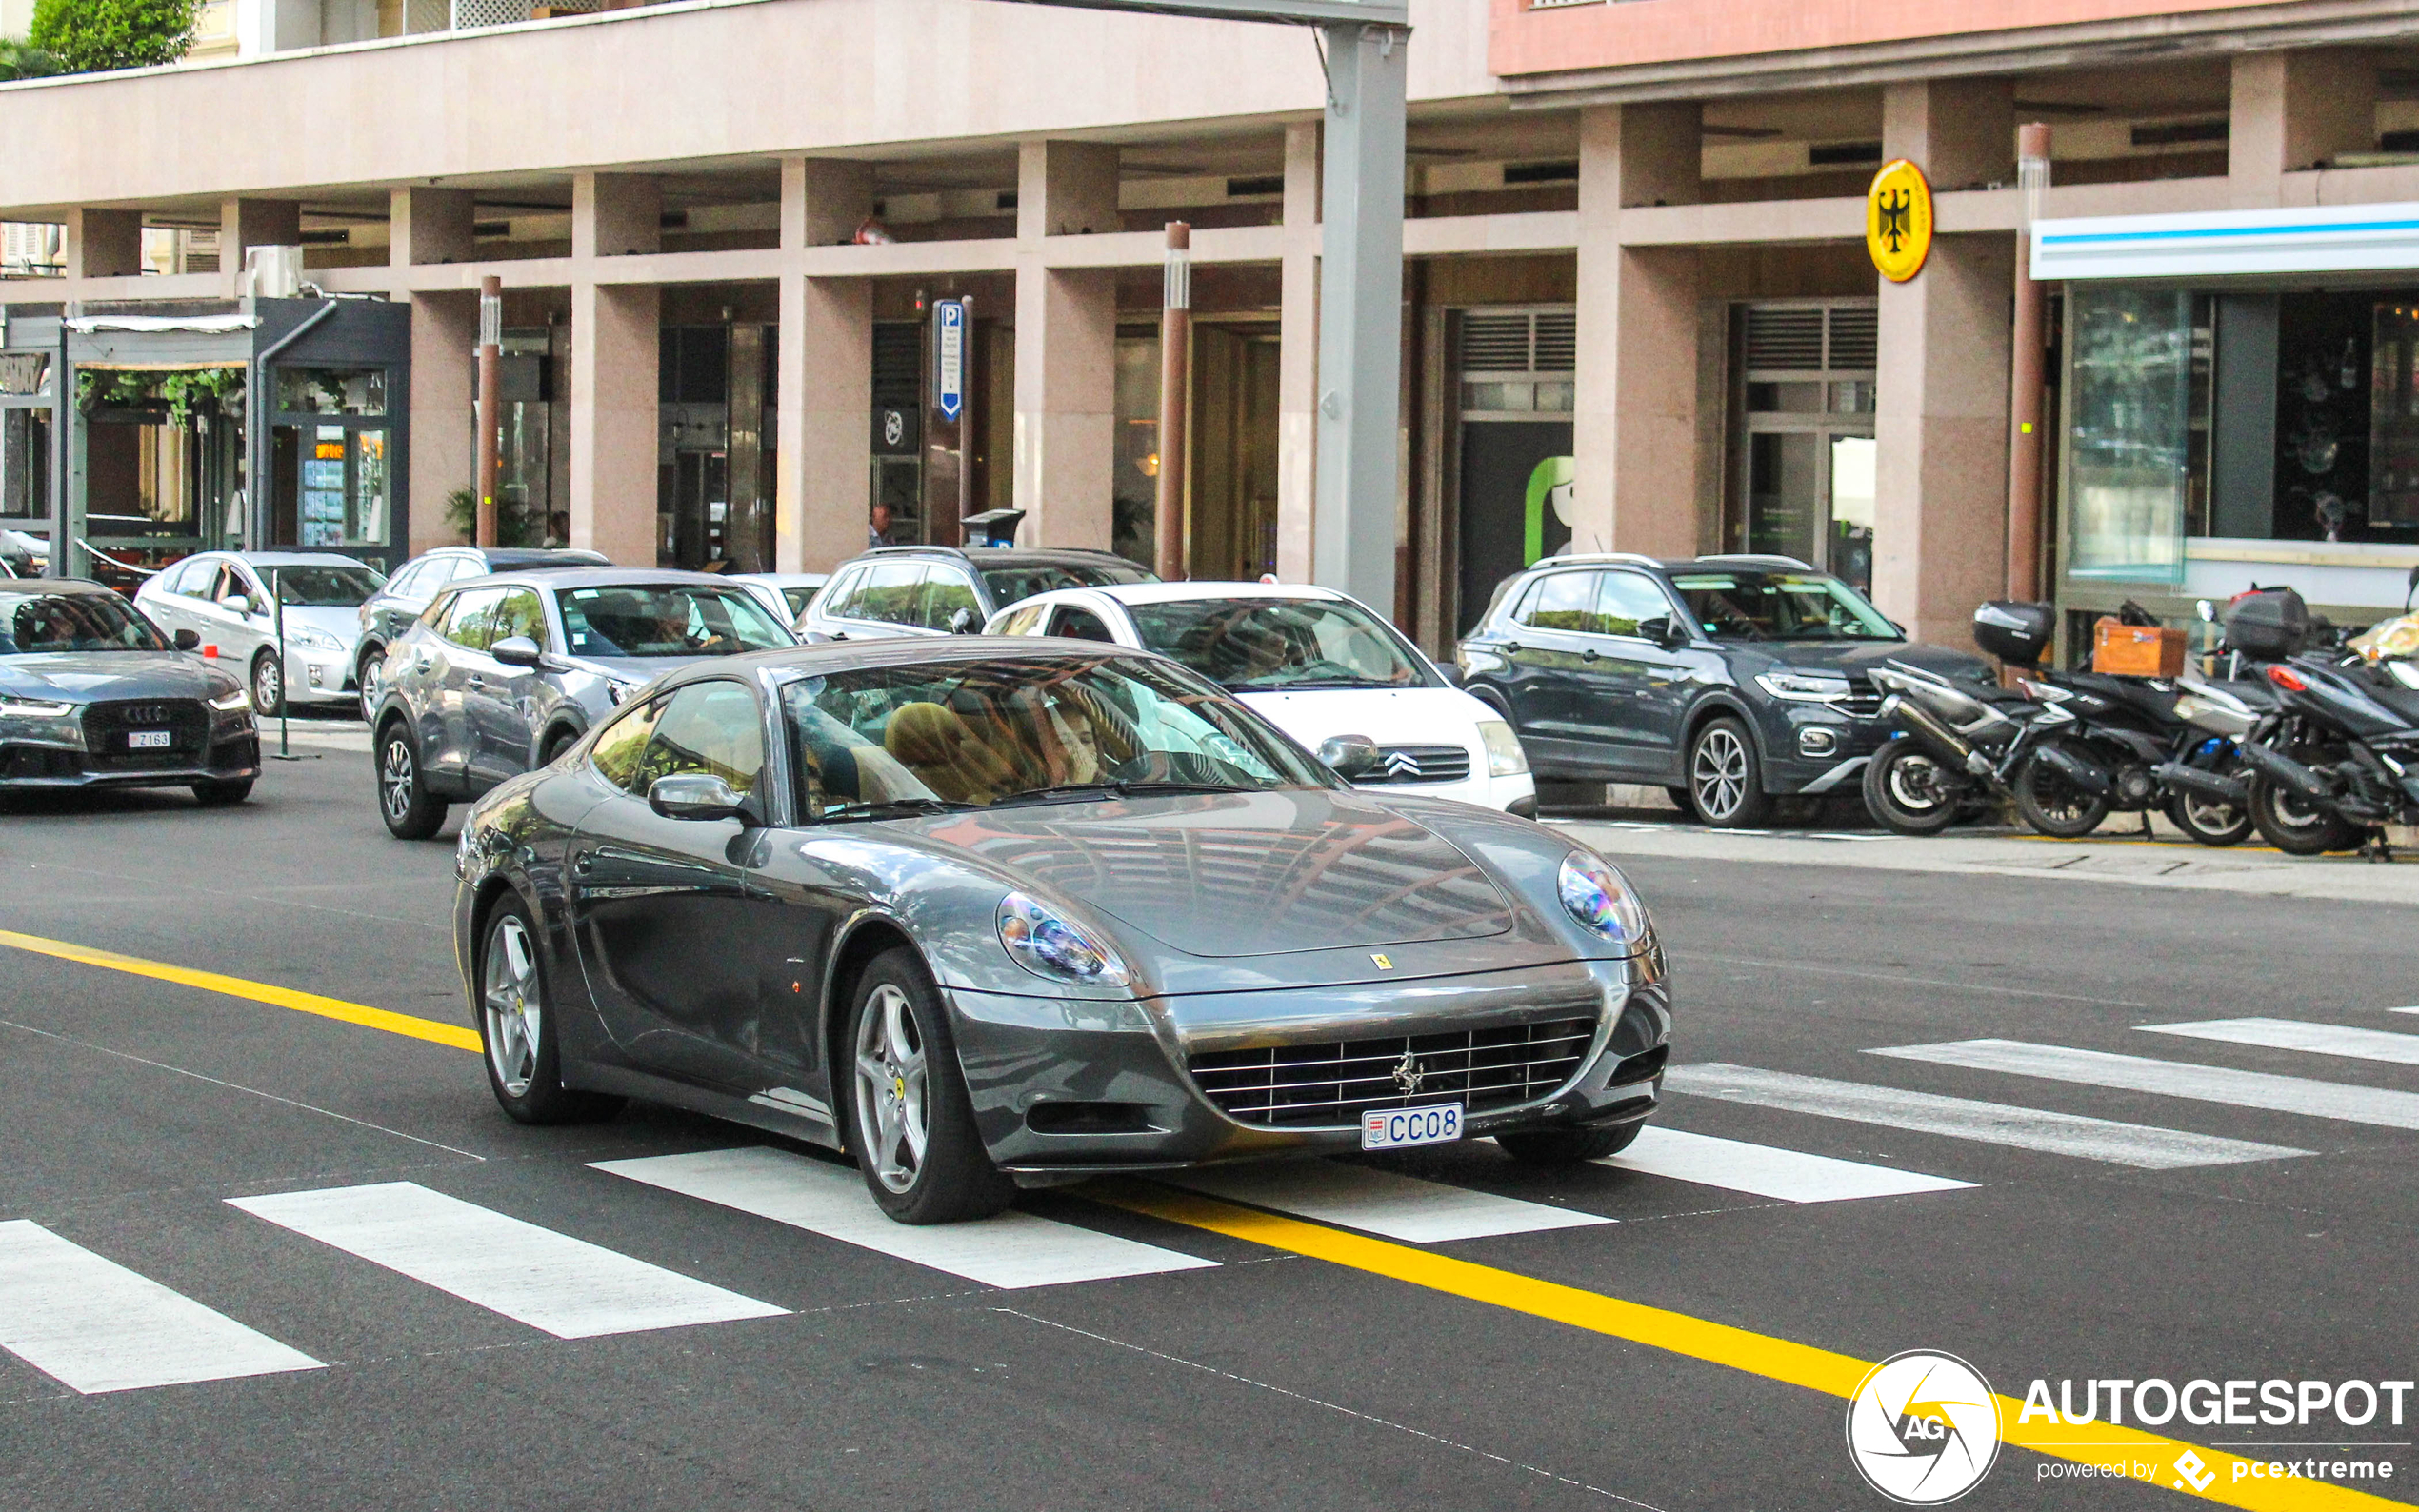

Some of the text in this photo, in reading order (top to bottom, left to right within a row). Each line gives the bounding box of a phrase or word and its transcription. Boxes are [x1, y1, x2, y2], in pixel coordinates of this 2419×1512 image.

[946, 308, 957, 326] P
[140, 734, 168, 746] Z163
[1391, 1109, 1457, 1142] CC08
